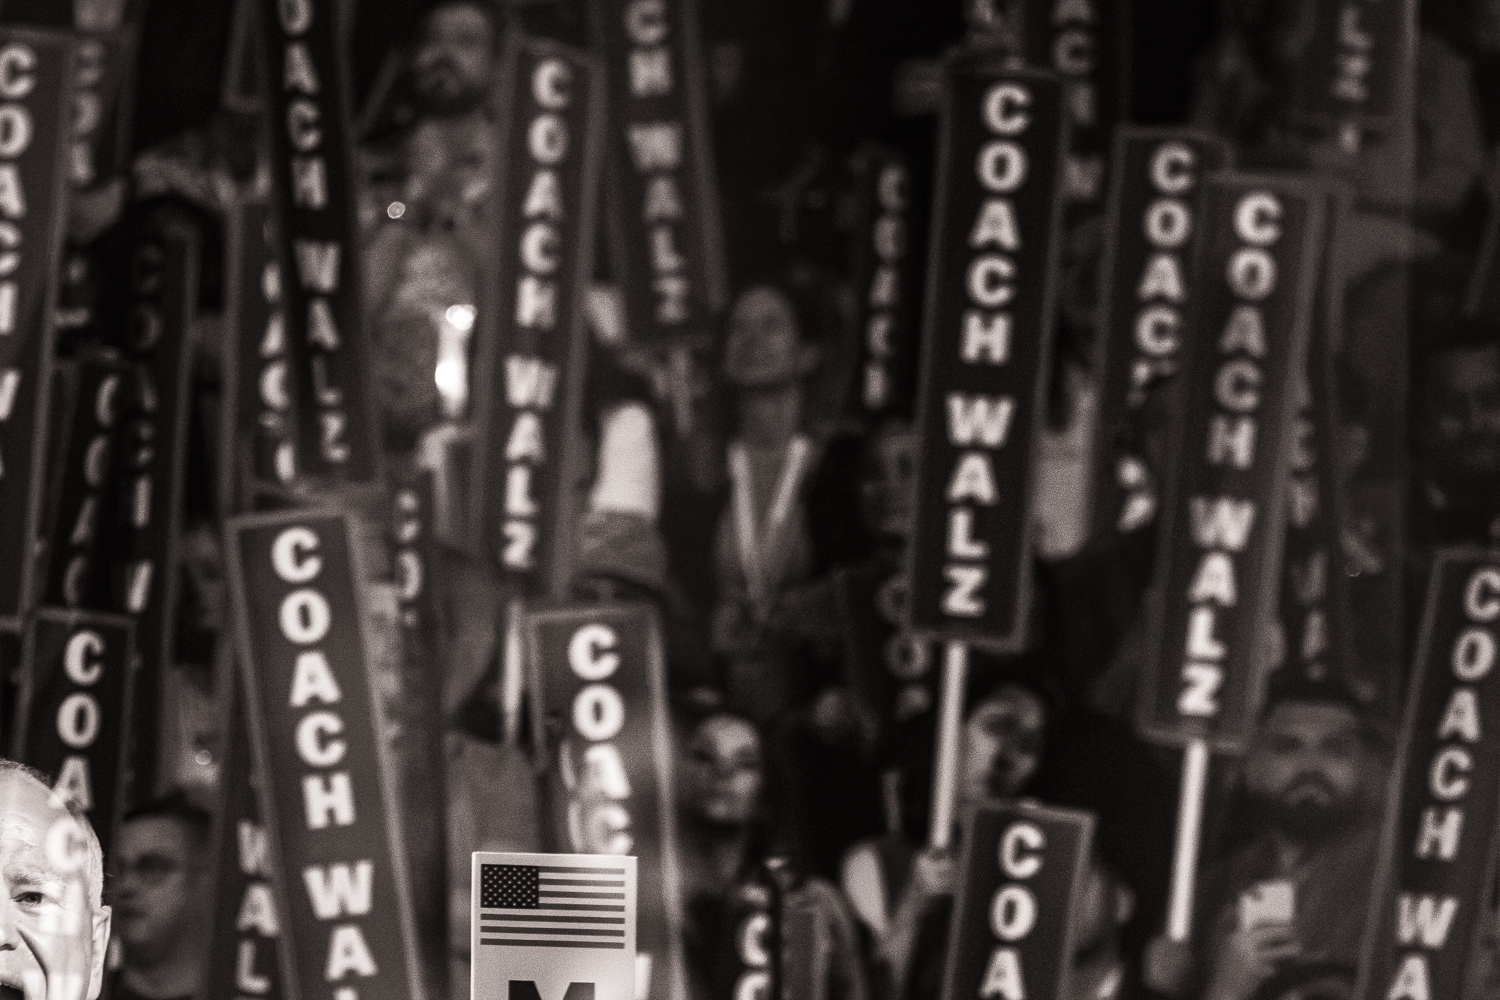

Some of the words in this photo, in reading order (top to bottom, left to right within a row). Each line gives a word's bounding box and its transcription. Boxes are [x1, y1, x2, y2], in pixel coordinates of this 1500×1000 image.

[517, 57, 574, 329] COACH
[626, 122, 689, 325] WALZ
[961, 82, 1033, 365] COACH
[1131, 141, 1197, 407] COAC
[293, 238, 350, 464] WALZ
[503, 354, 560, 568] WALZ
[1206, 190, 1284, 471] COACH
[940, 392, 1015, 617] WALZ
[1177, 497, 1256, 717] WALZ
[271, 526, 356, 830] COACH
[1414, 567, 1500, 862] COACH
